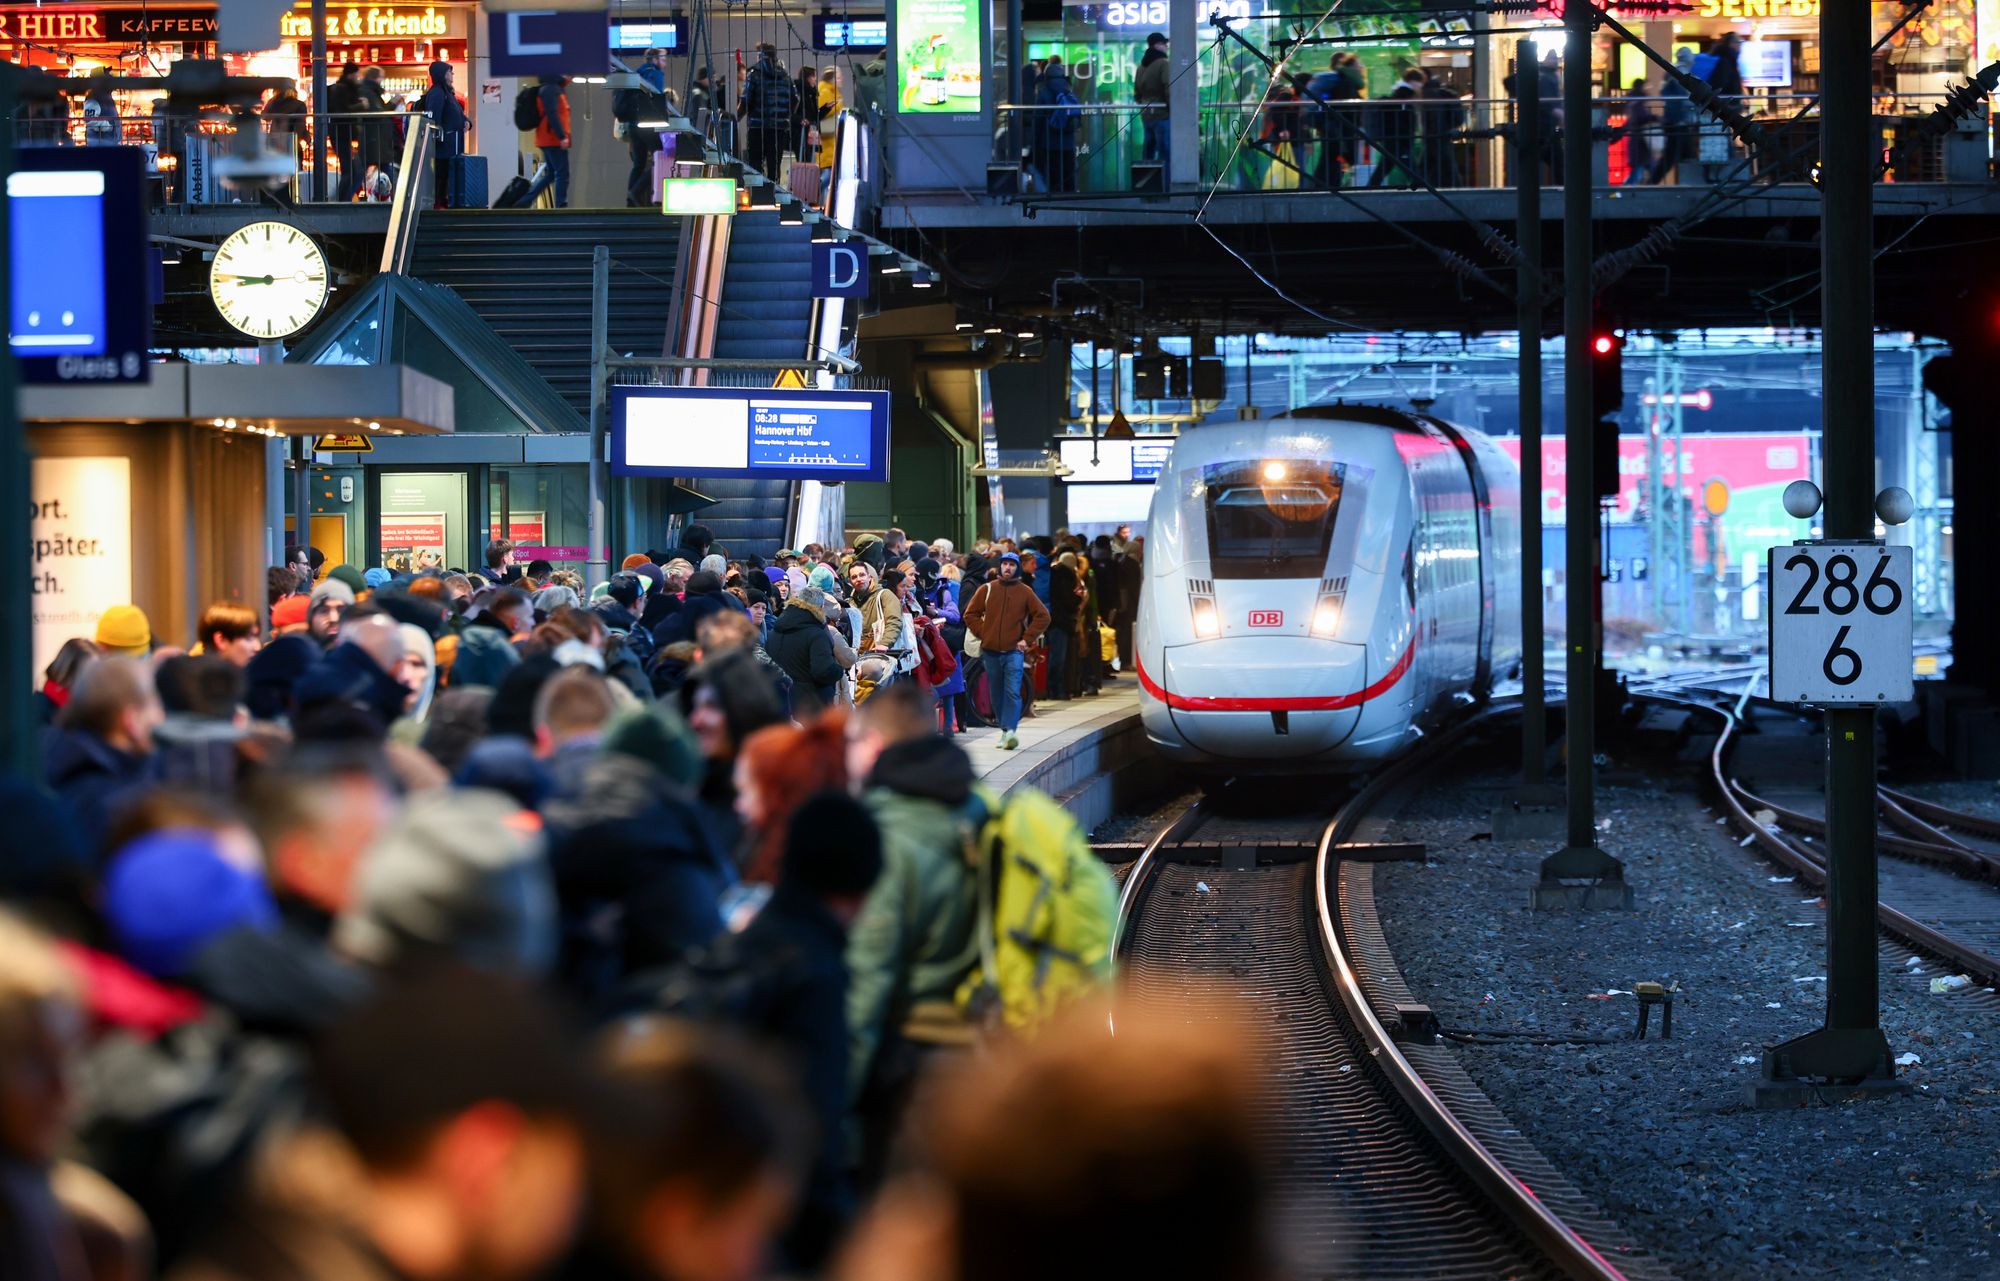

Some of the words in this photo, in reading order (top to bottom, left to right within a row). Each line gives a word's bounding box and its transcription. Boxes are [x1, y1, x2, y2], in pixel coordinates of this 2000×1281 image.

[17, 14, 101, 39] HIER
[281, 11, 339, 36] fraz
[344, 8, 363, 36] &
[367, 7, 447, 36] friends
[829, 247, 859, 288] D
[56, 353, 119, 379] Gleis
[122, 352, 140, 378] 8
[755, 414, 779, 424] 08:28
[755, 424, 796, 437] Hannover
[797, 425, 813, 437] Hbf
[1783, 554, 1902, 615] 286
[1251, 612, 1281, 625] DB
[1822, 625, 1862, 686] 6
